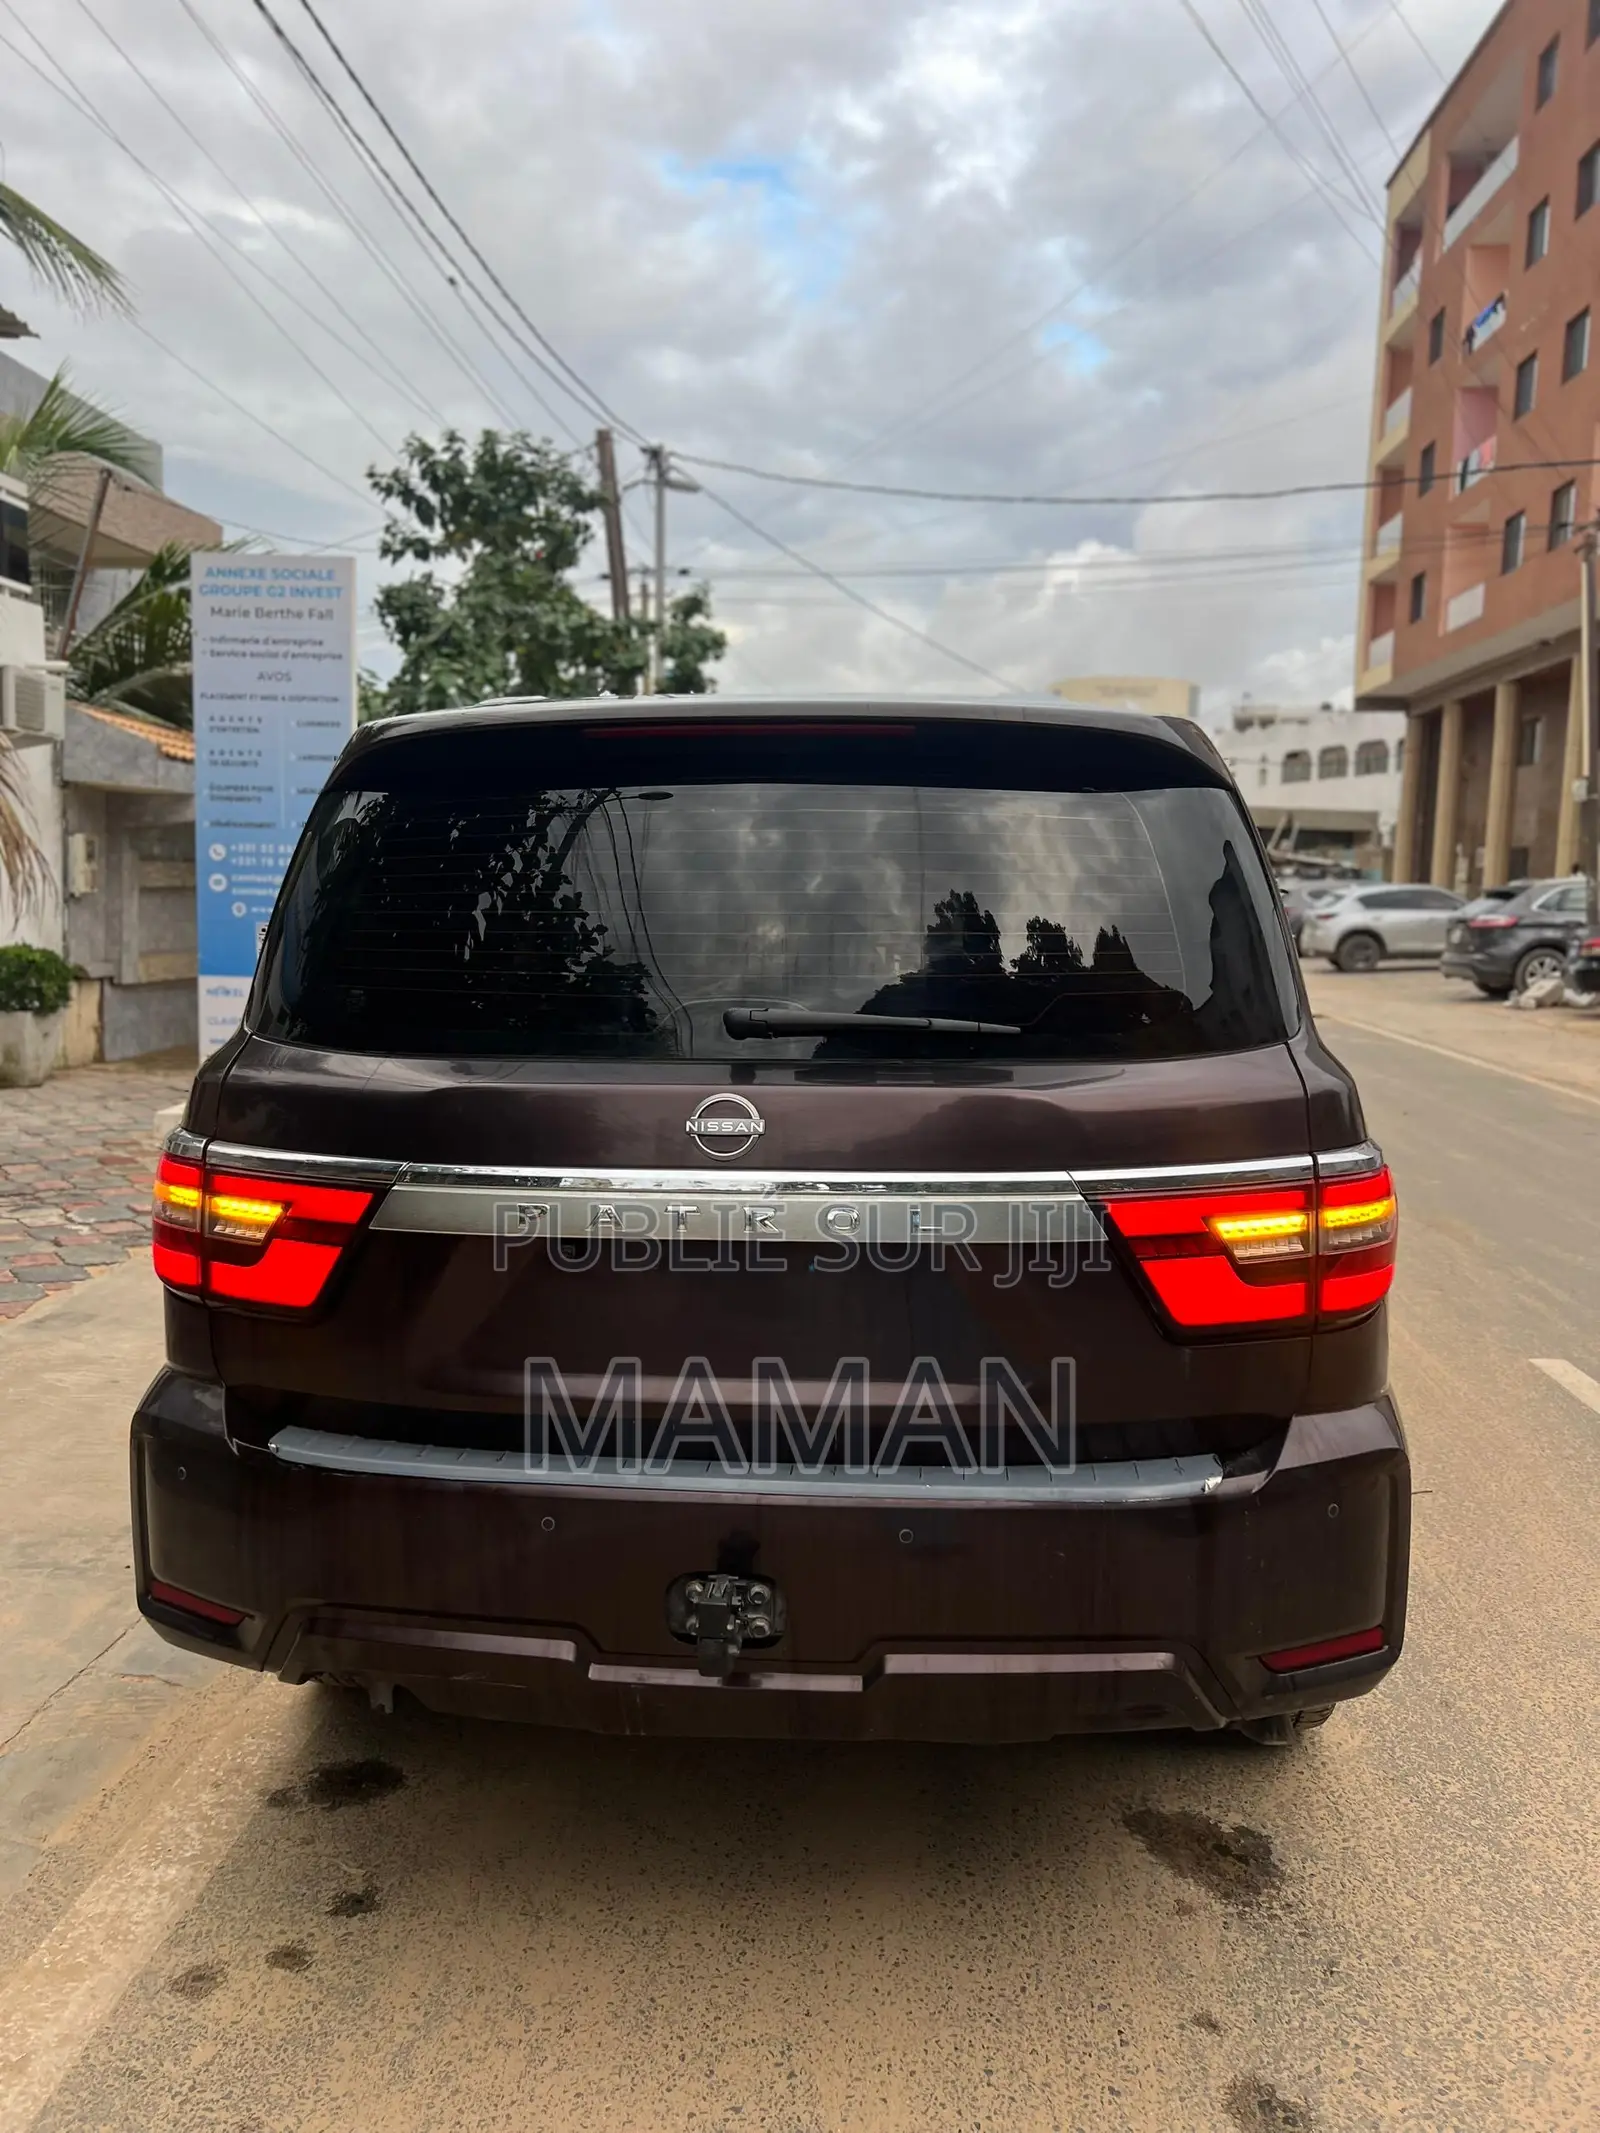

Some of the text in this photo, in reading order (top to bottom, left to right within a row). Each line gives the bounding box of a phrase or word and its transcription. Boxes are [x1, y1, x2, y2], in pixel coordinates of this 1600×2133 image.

[205, 567, 335, 581] ANNEXE SOCIALE
[199, 584, 344, 599] GROUPE G2 INVEST
[210, 606, 334, 620] Marie Berthe Fall
[257, 672, 293, 683] AVOS
[686, 1120, 763, 1133] NISSAN
[516, 1203, 943, 1235] PATROL
